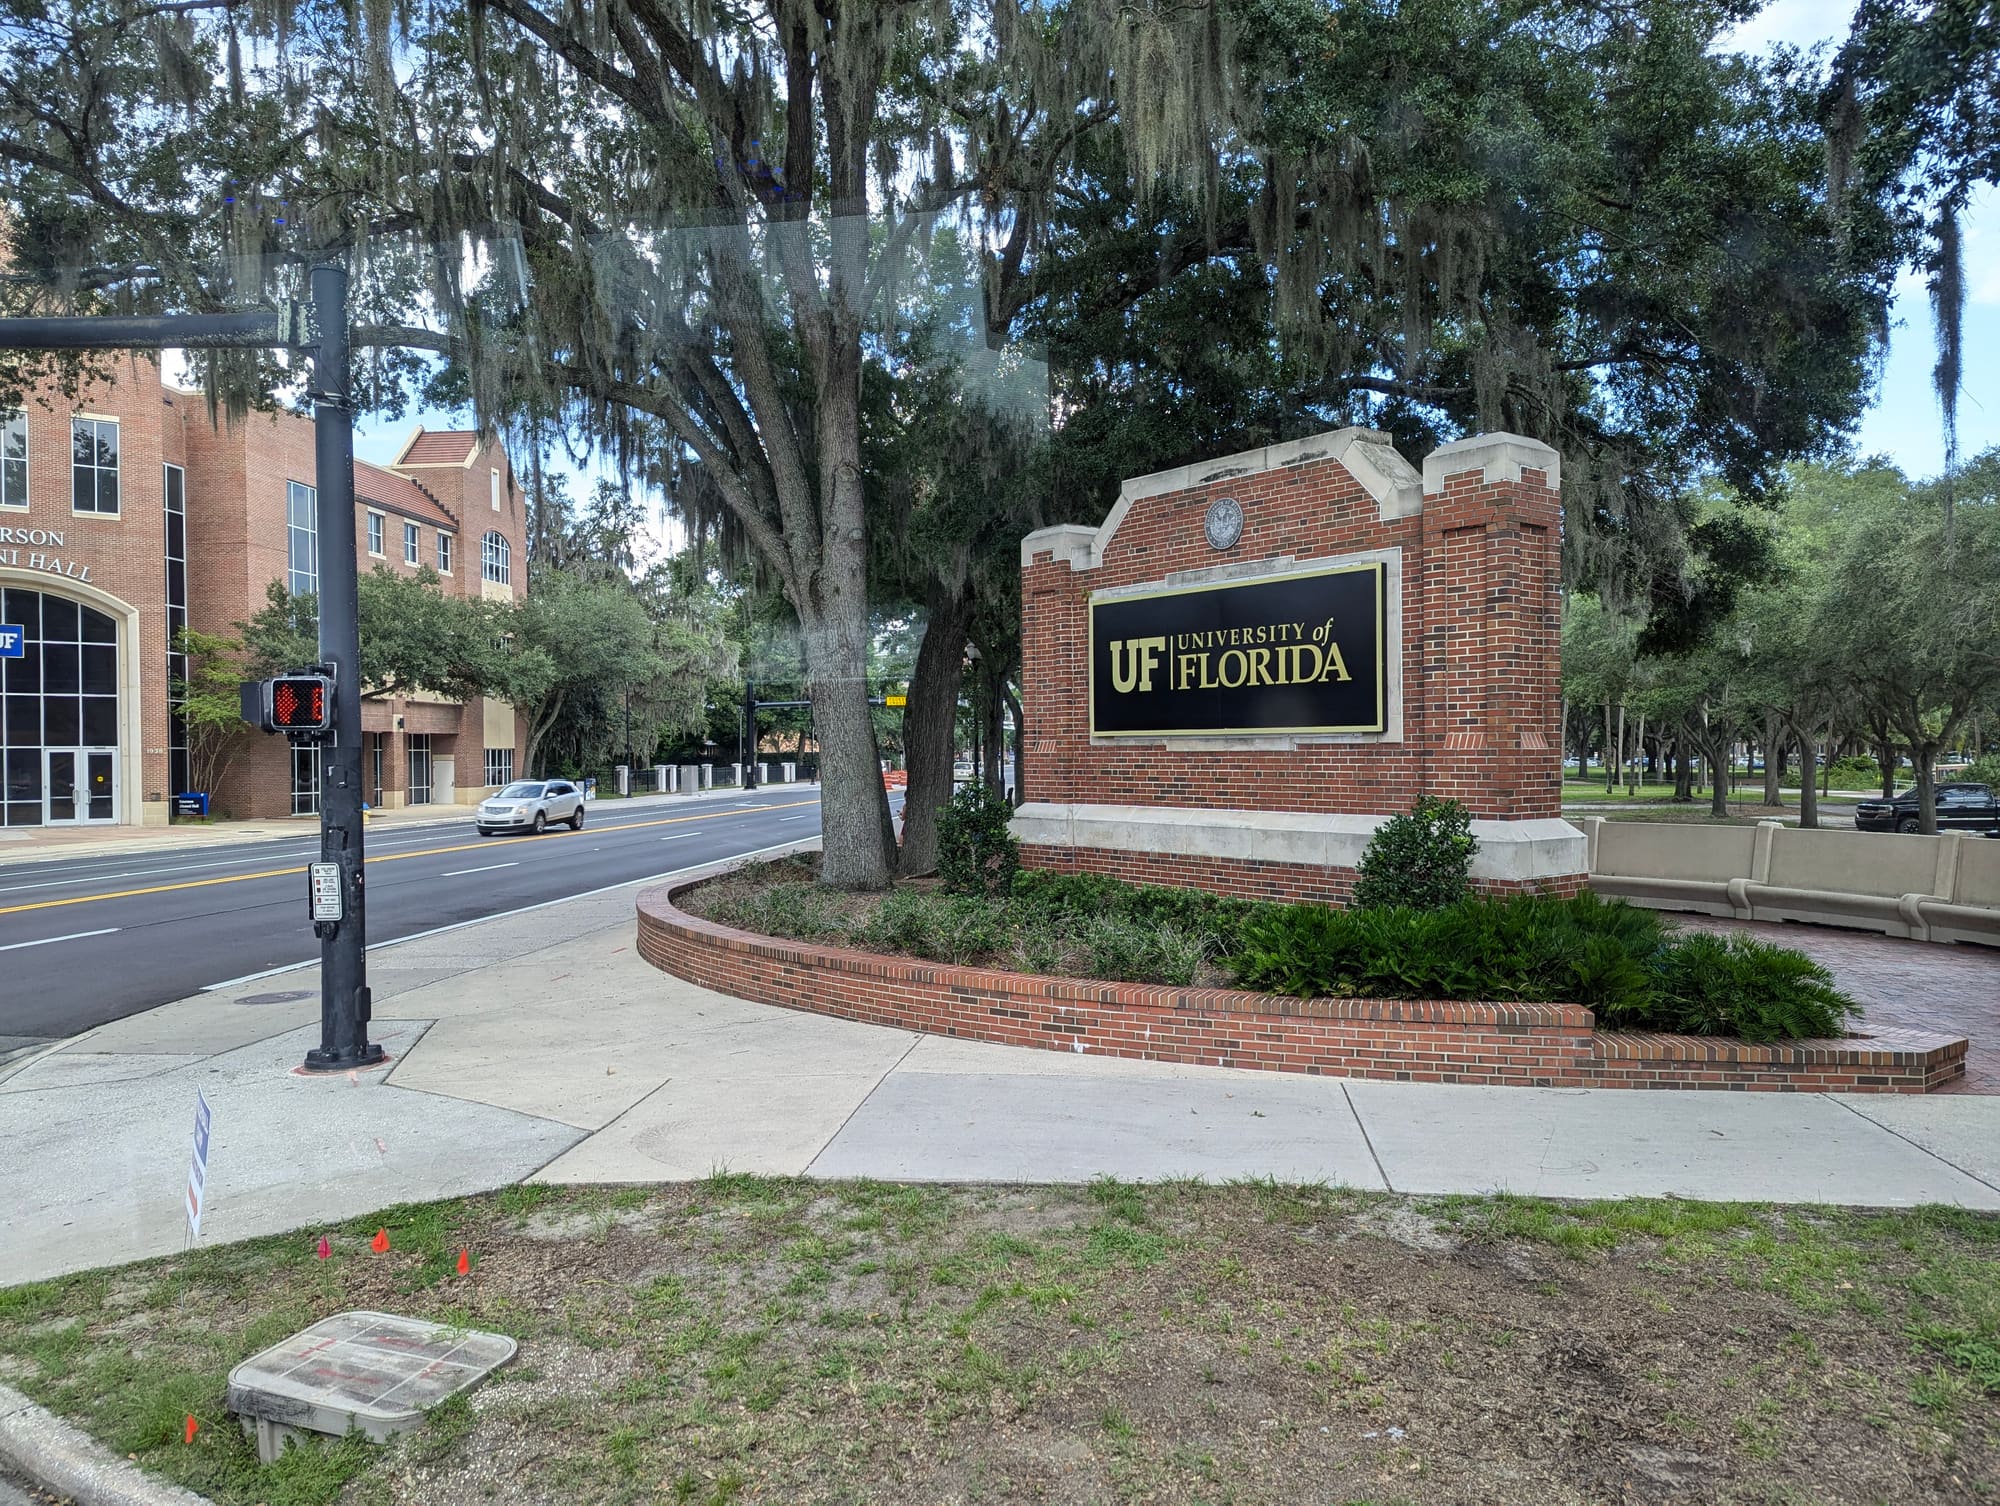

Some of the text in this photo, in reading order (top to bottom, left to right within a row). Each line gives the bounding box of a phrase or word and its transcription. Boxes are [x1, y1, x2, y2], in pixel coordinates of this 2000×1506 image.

[0, 527, 64, 546] RSON
[29, 552, 93, 583] HALL
[1177, 617, 1334, 650] UNIVERSITY of
[1110, 636, 1166, 694] UF
[1177, 642, 1352, 690] FLORIDA
